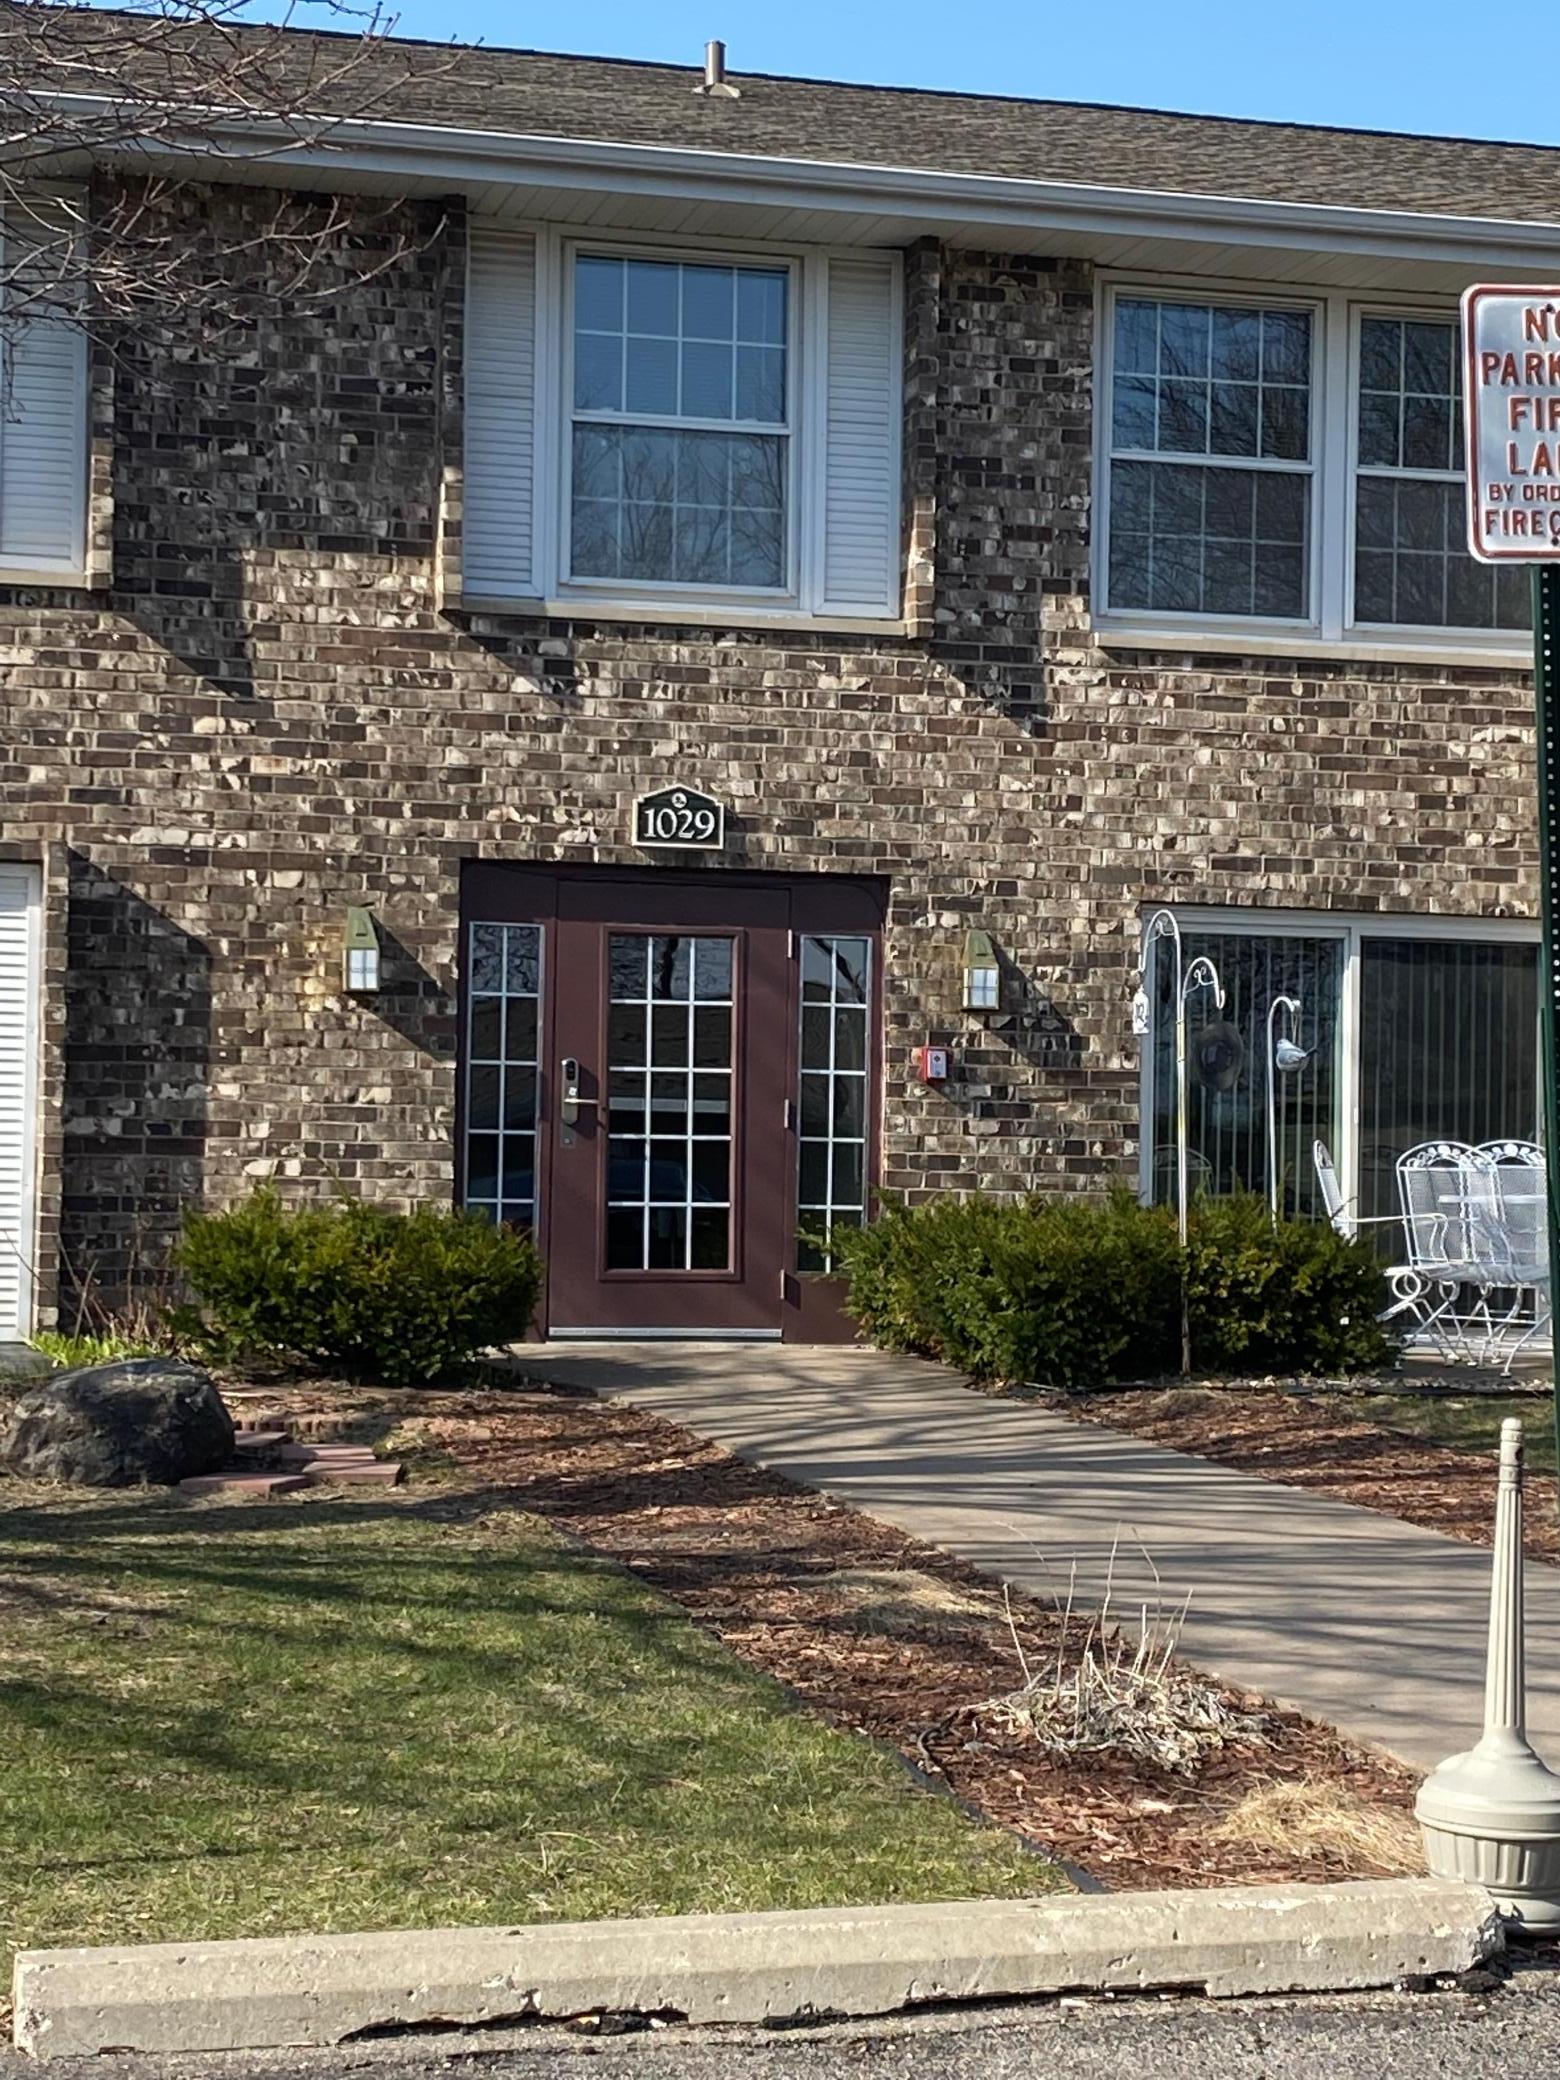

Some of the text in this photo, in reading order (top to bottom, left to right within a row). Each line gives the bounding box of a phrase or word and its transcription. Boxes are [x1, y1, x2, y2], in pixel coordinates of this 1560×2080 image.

[1524, 308, 1560, 343] N
[1509, 441, 1560, 476] LA
[1488, 483, 1514, 502] BY
[643, 807, 716, 841] 1029
